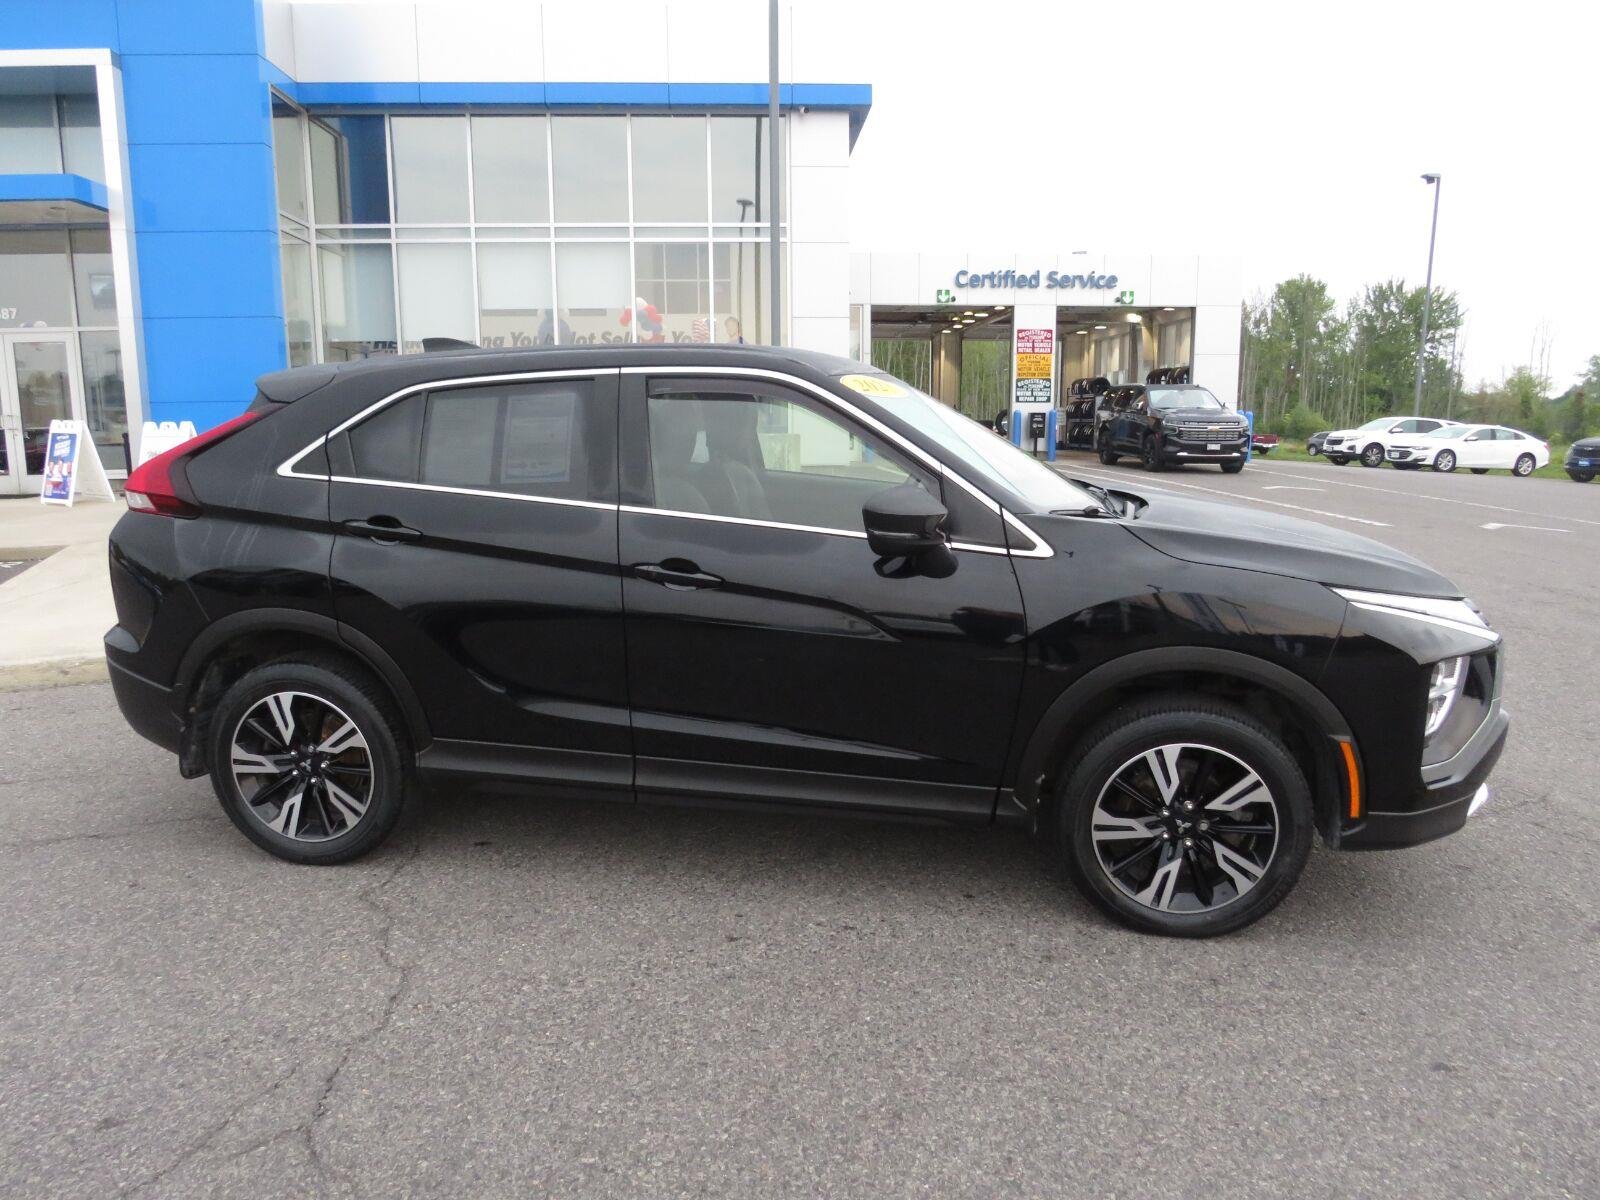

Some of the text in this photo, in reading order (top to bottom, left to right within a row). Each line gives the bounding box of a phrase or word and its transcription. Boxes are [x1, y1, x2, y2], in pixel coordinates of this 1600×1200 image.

[955, 270, 1118, 289] Certified Service
[1018, 330, 1052, 339] REGISTERED
[1019, 355, 1049, 363] OFFICIAL
[1017, 379, 1051, 387] REGISTERED
